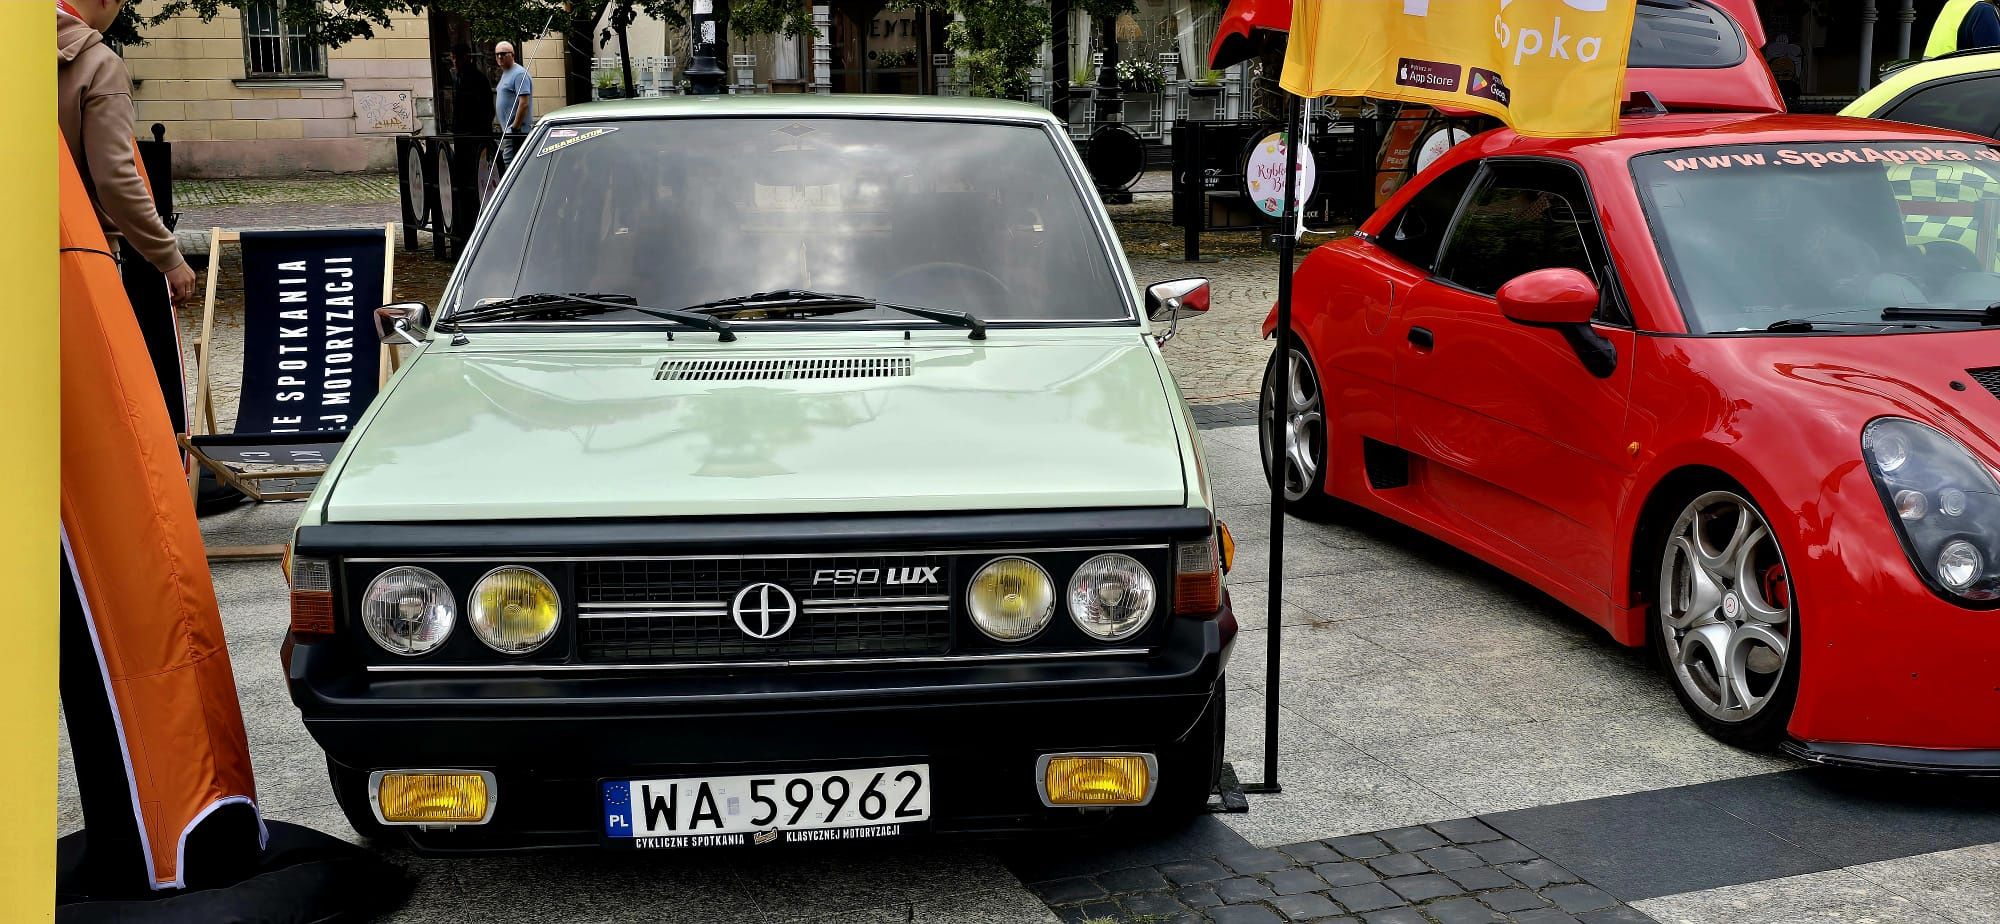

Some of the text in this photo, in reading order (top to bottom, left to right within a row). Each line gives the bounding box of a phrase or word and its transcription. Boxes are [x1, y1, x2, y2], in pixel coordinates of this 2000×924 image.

[1410, 71, 1454, 86] App Store
[275, 260, 308, 401] SPOTKANIA
[321, 257, 354, 405] MOTORYZACJI
[813, 566, 941, 586] FSO LUX
[641, 770, 923, 832] WA 59962
[609, 814, 629, 828] PL
[636, 836, 689, 849] CYKLICZNE
[691, 833, 745, 847] SPOTKANIA
[786, 827, 840, 842] KLASYCZNEJ
[842, 824, 901, 839] MOTORYZACJI
